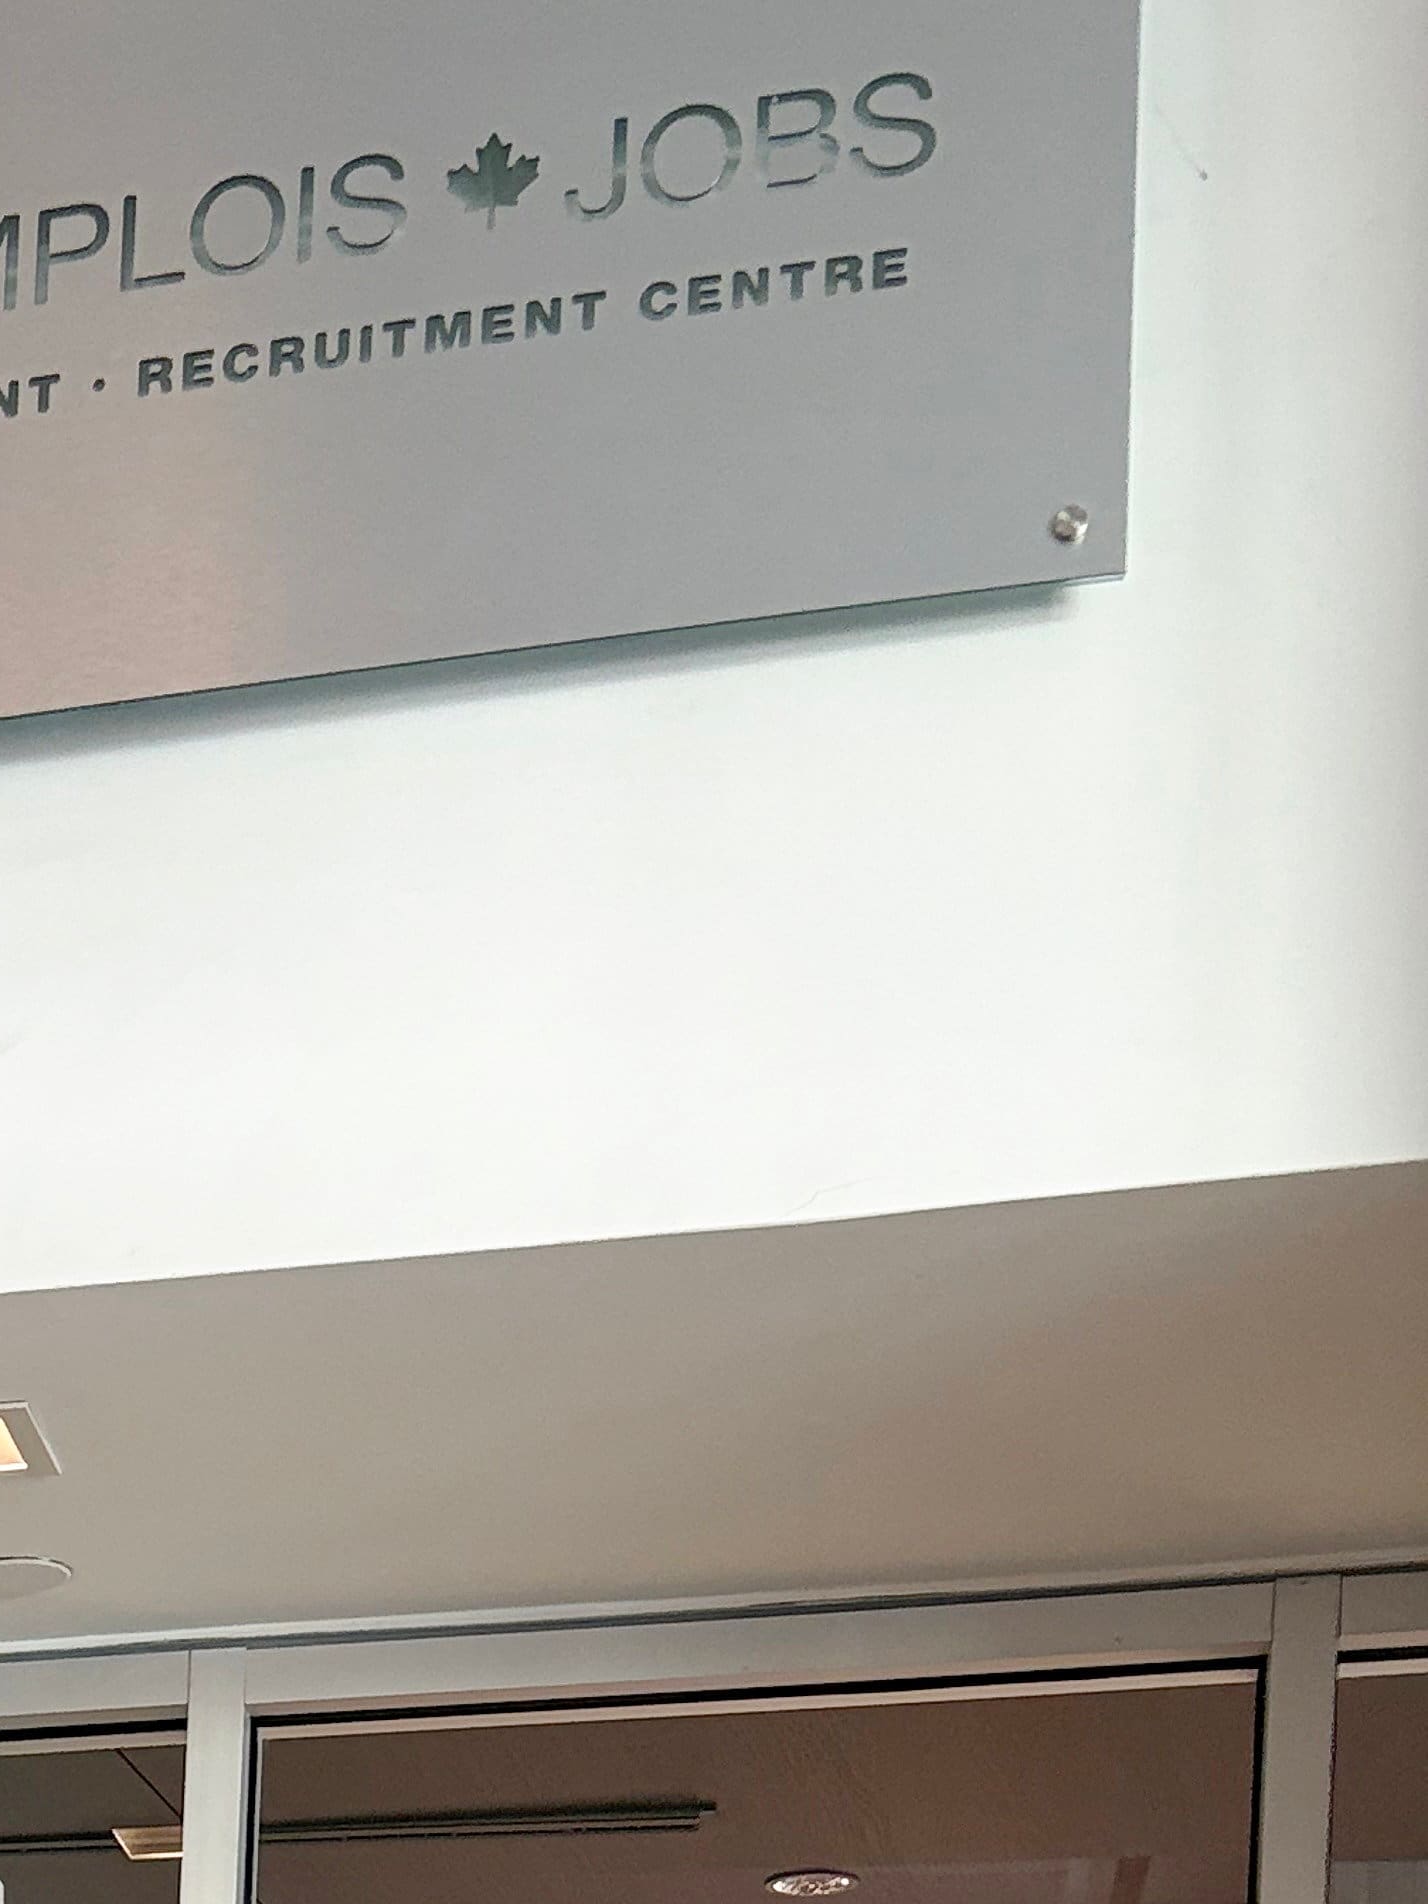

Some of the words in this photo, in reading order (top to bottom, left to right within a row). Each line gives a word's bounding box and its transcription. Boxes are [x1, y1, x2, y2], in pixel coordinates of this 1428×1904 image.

[564, 72, 938, 222] JOBS
[137, 290, 607, 398] RECRUITMENT
[638, 247, 910, 321] CENTRE
